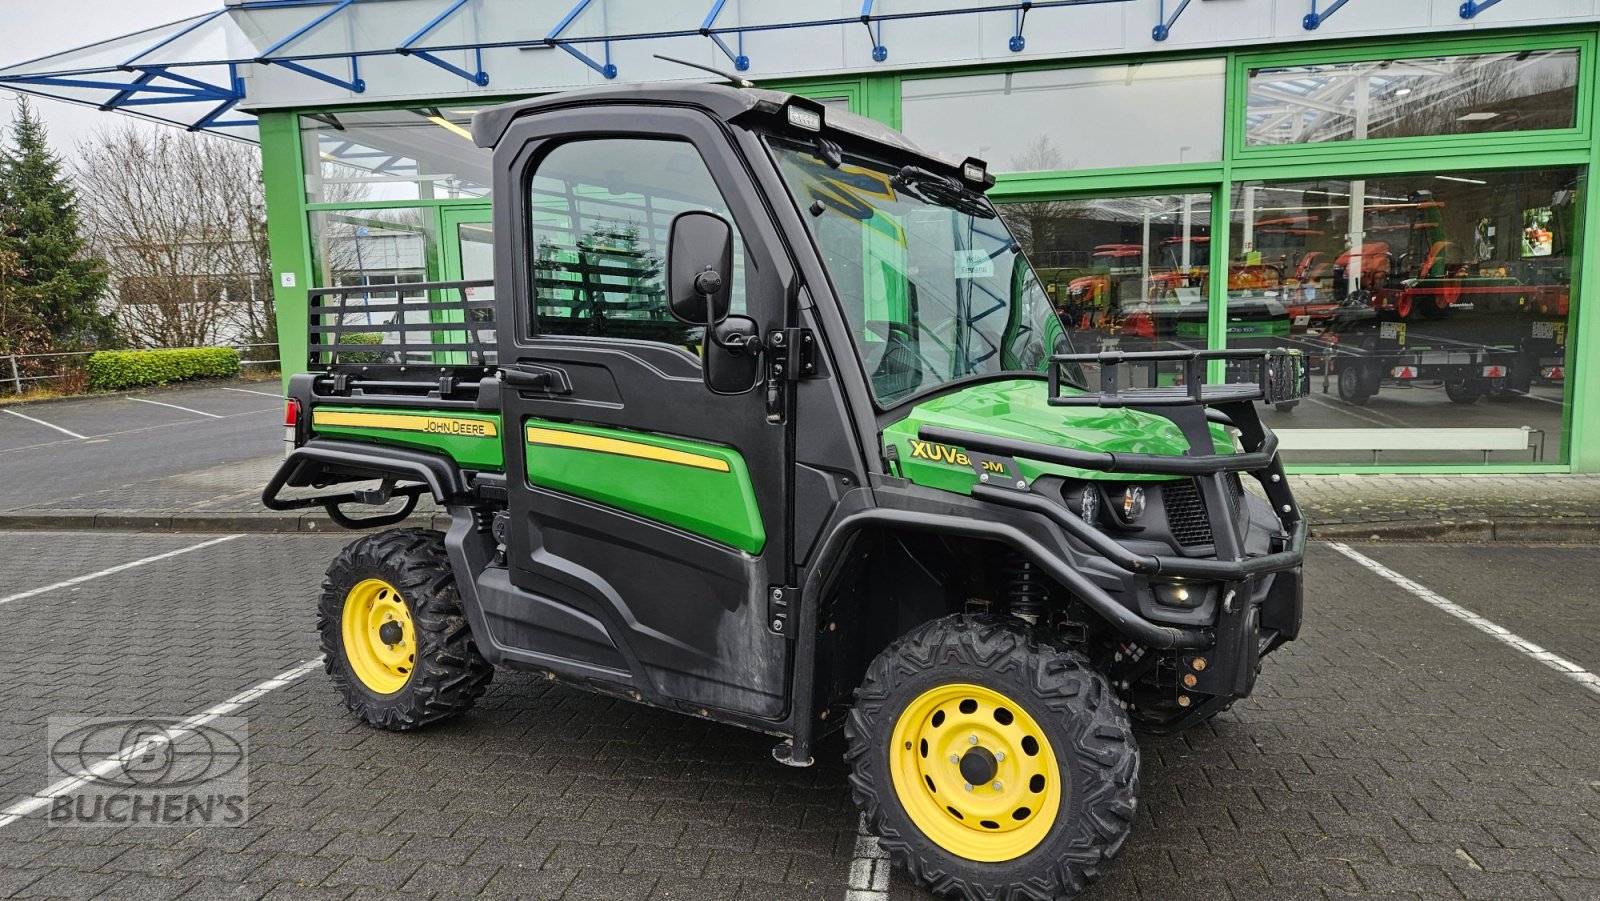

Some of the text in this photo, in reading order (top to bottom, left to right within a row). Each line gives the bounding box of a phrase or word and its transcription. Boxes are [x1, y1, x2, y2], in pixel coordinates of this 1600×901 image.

[424, 419, 485, 435] JOHN DEERE
[909, 440, 1004, 473] XUV8M
